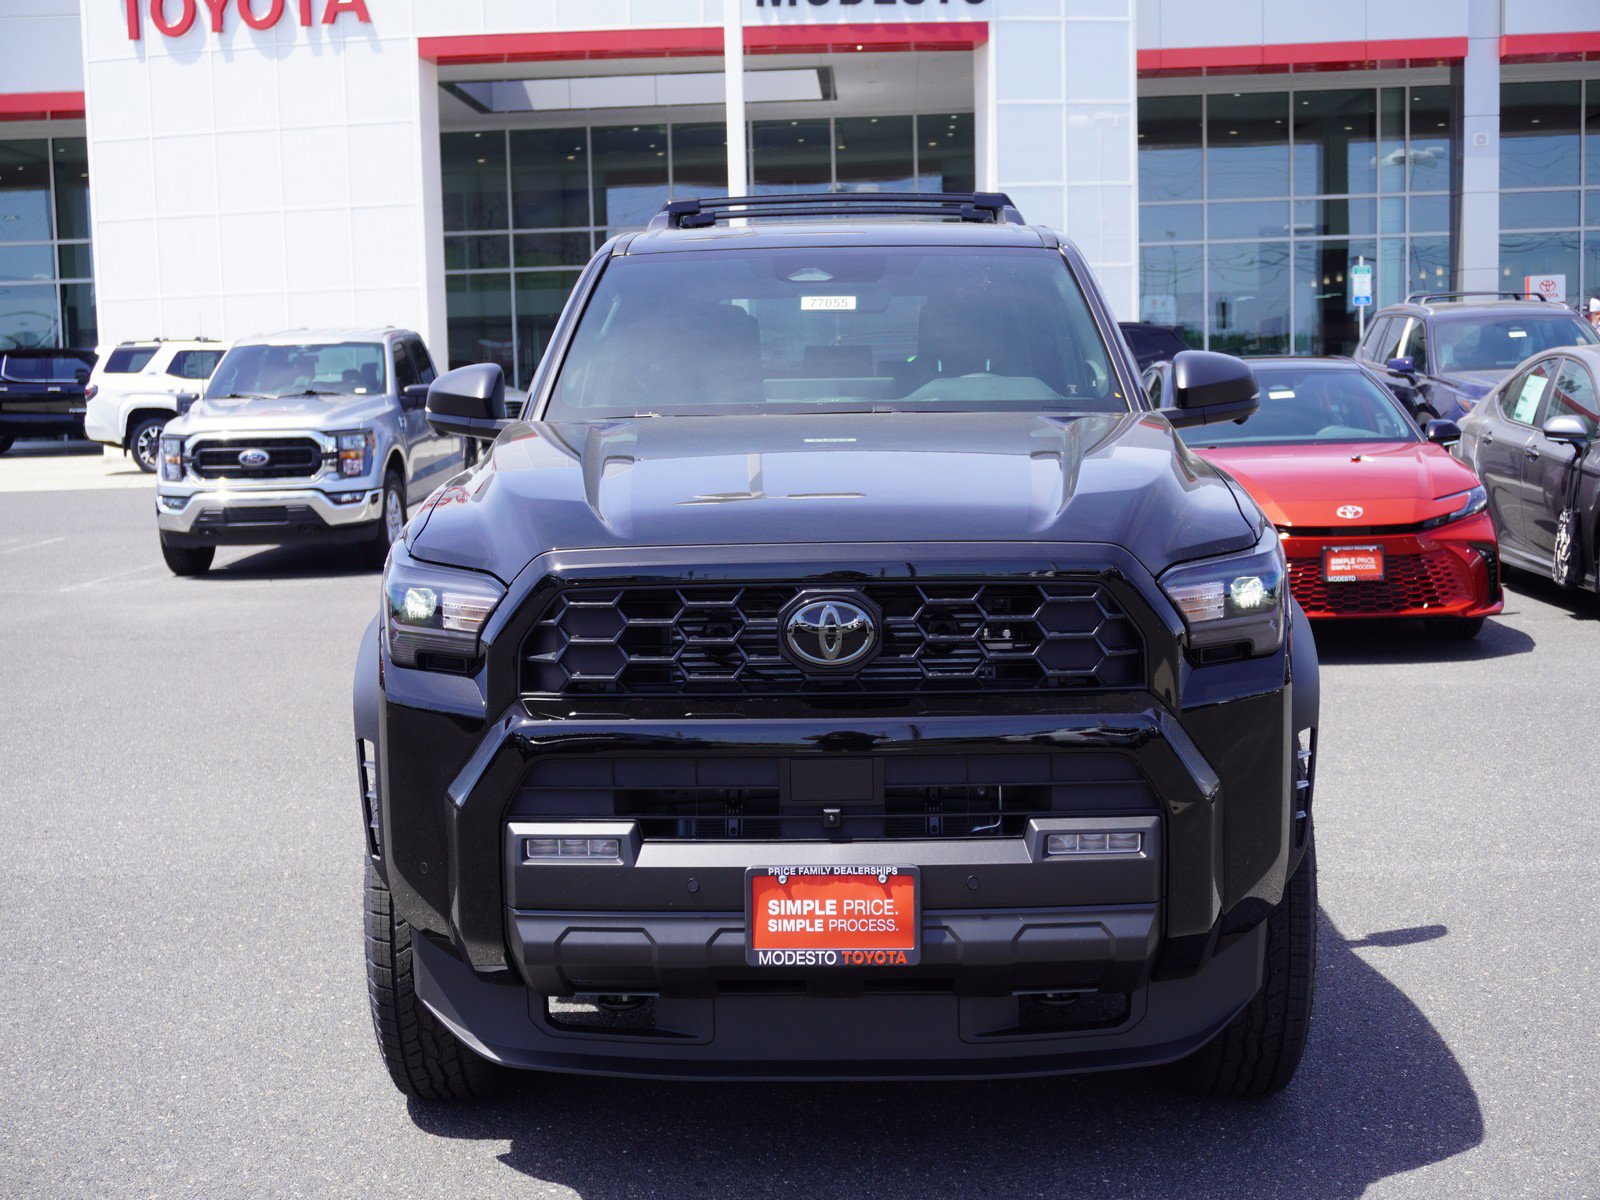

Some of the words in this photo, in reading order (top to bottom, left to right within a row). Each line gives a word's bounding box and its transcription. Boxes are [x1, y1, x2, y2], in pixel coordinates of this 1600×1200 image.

[810, 298, 848, 308] 77055
[768, 867, 796, 876] PRICE
[798, 867, 831, 875] FAMILY
[834, 867, 898, 875] DEALERSHIPS
[767, 899, 837, 916] SIMPLE
[843, 899, 899, 915] PRICE.
[767, 919, 824, 932] SIMPLE
[828, 919, 899, 932] PROCESS.
[758, 951, 837, 965] MODESTO
[842, 951, 907, 965] TOYOTA
